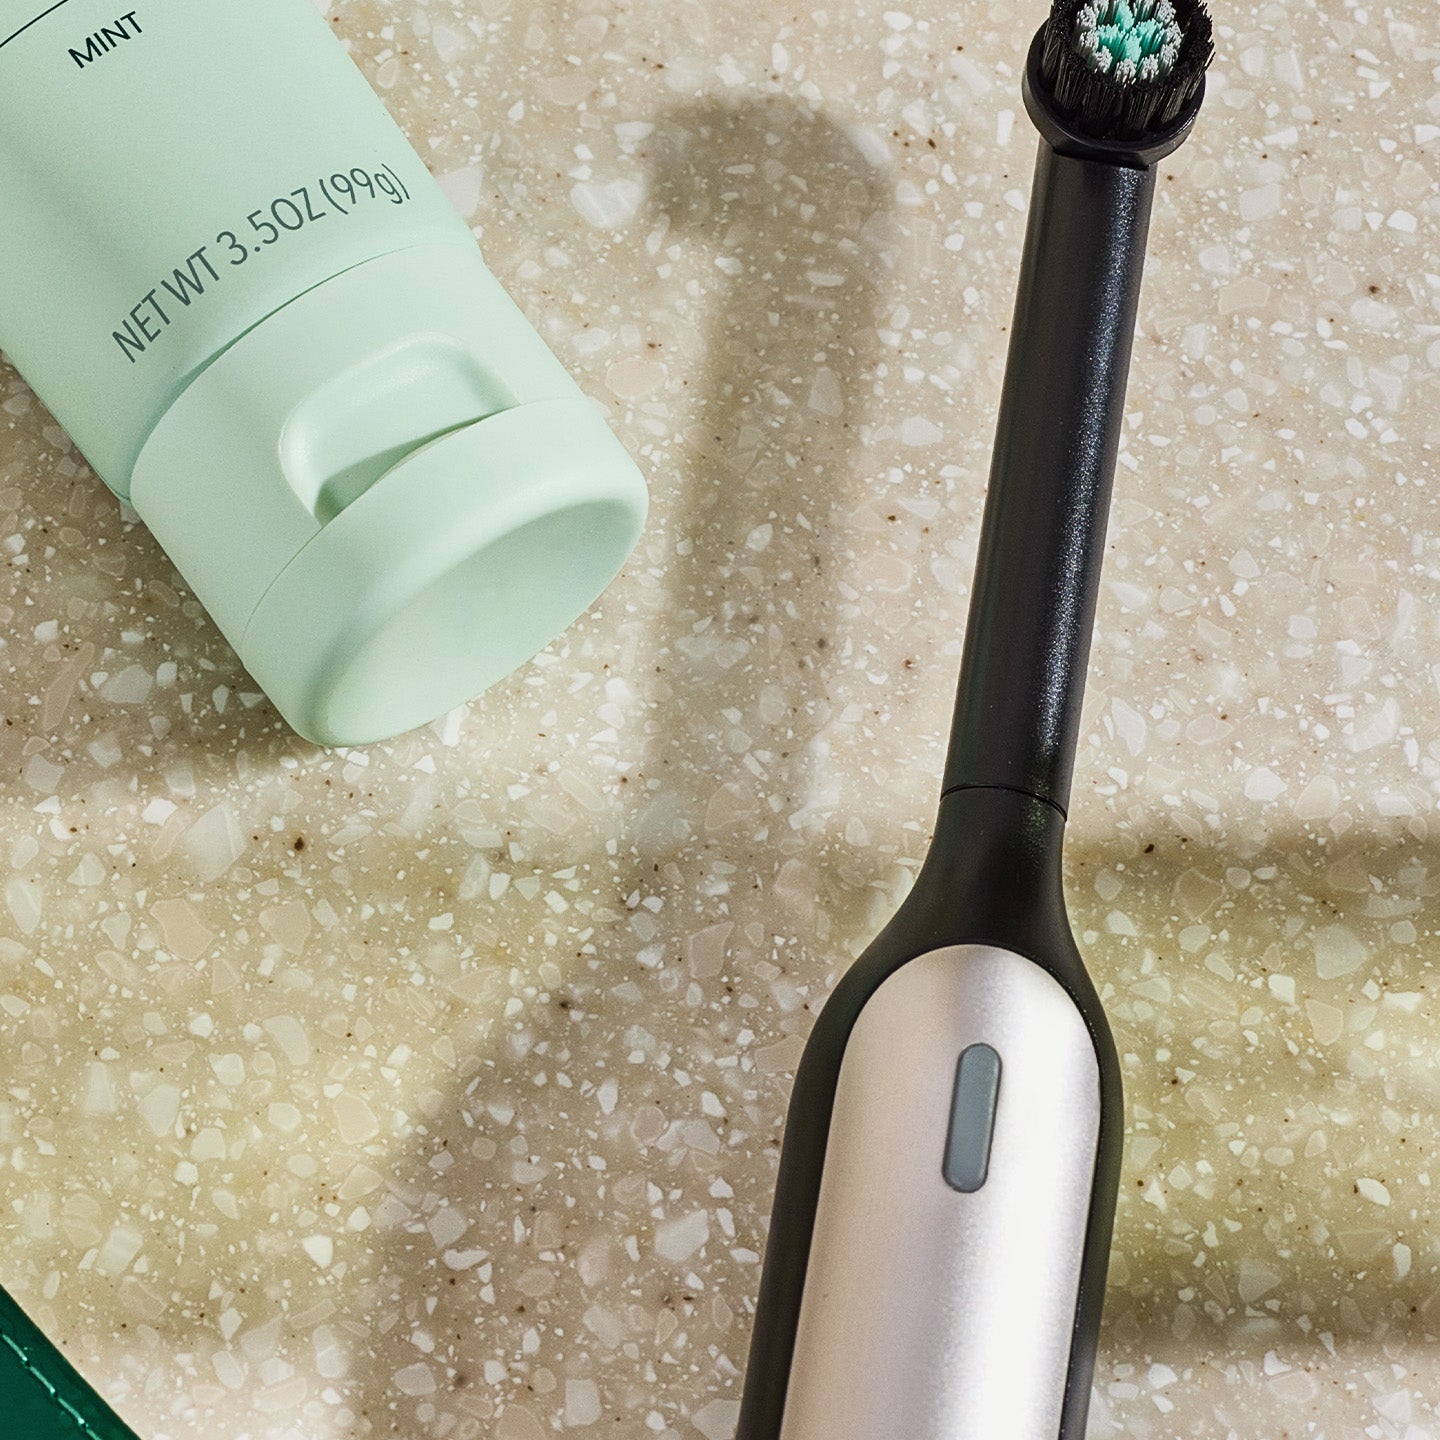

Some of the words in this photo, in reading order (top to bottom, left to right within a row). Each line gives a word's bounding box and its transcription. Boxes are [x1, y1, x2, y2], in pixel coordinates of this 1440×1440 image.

[67, 10, 143, 69] MINT
[111, 288, 171, 364] NET
[160, 245, 220, 307] WT
